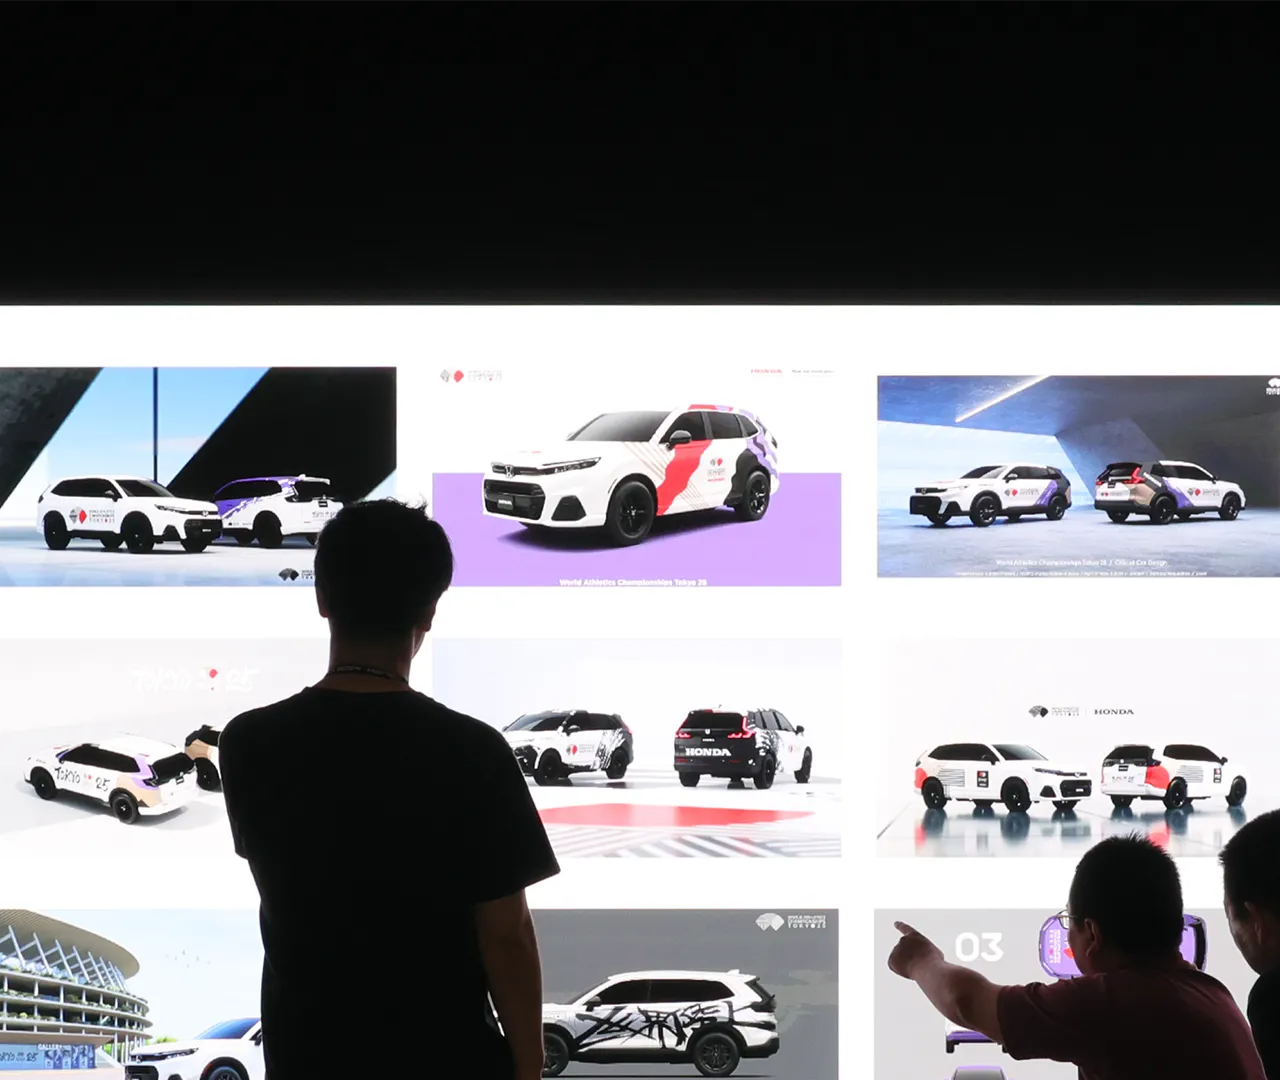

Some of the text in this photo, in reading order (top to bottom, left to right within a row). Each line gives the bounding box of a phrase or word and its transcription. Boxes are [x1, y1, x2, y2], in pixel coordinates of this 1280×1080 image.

[617, 579, 672, 587] Championships
[686, 747, 732, 756] HONDA
[95, 777, 111, 792] 25
[956, 932, 1004, 962] 03
